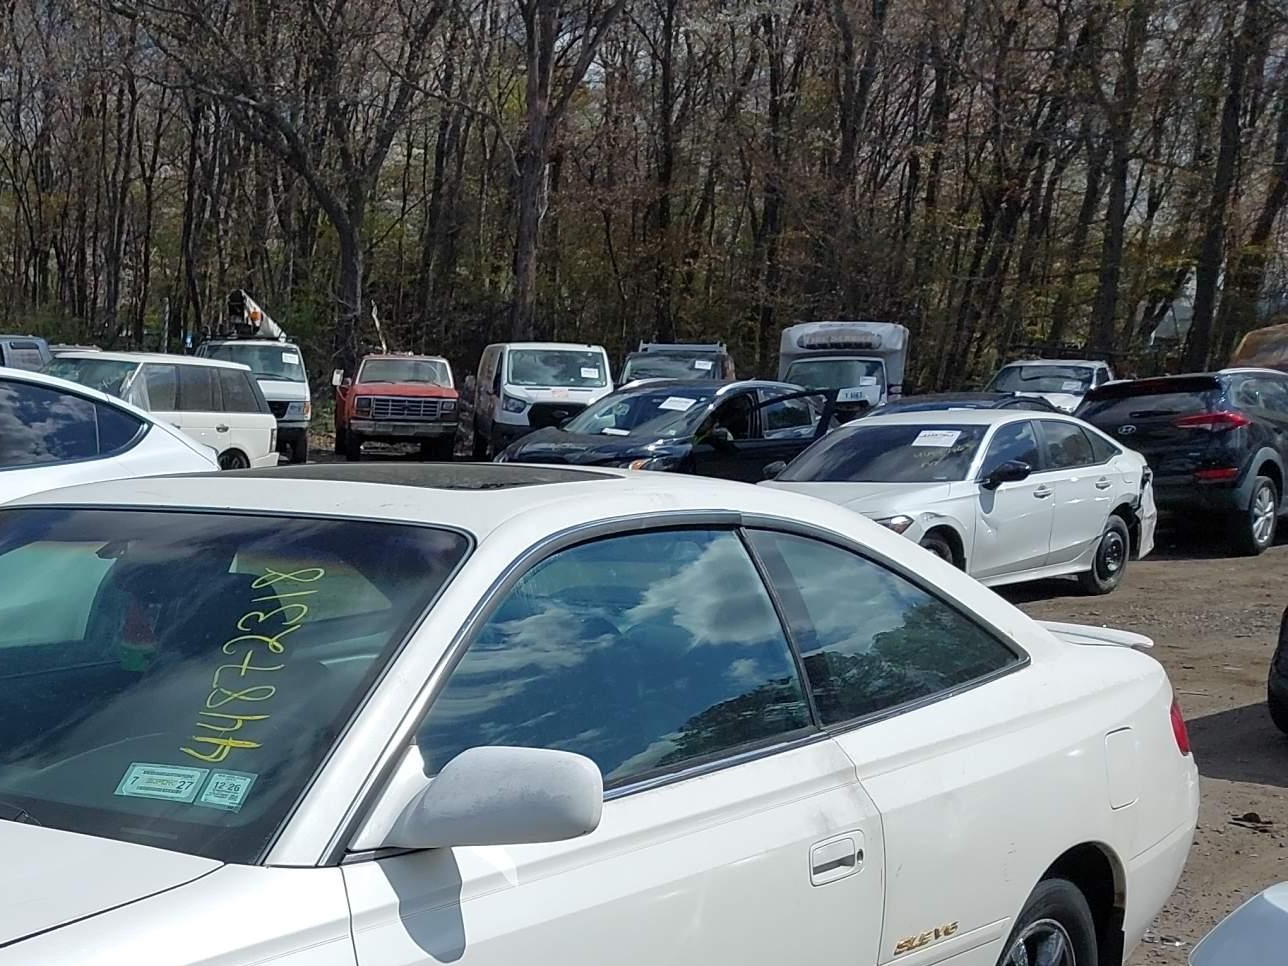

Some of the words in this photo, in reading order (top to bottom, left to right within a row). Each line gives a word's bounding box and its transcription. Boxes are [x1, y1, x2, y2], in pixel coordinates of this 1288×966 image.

[179, 567, 325, 762] 44872318
[128, 776, 140, 785] 7
[176, 780, 194, 791] 27
